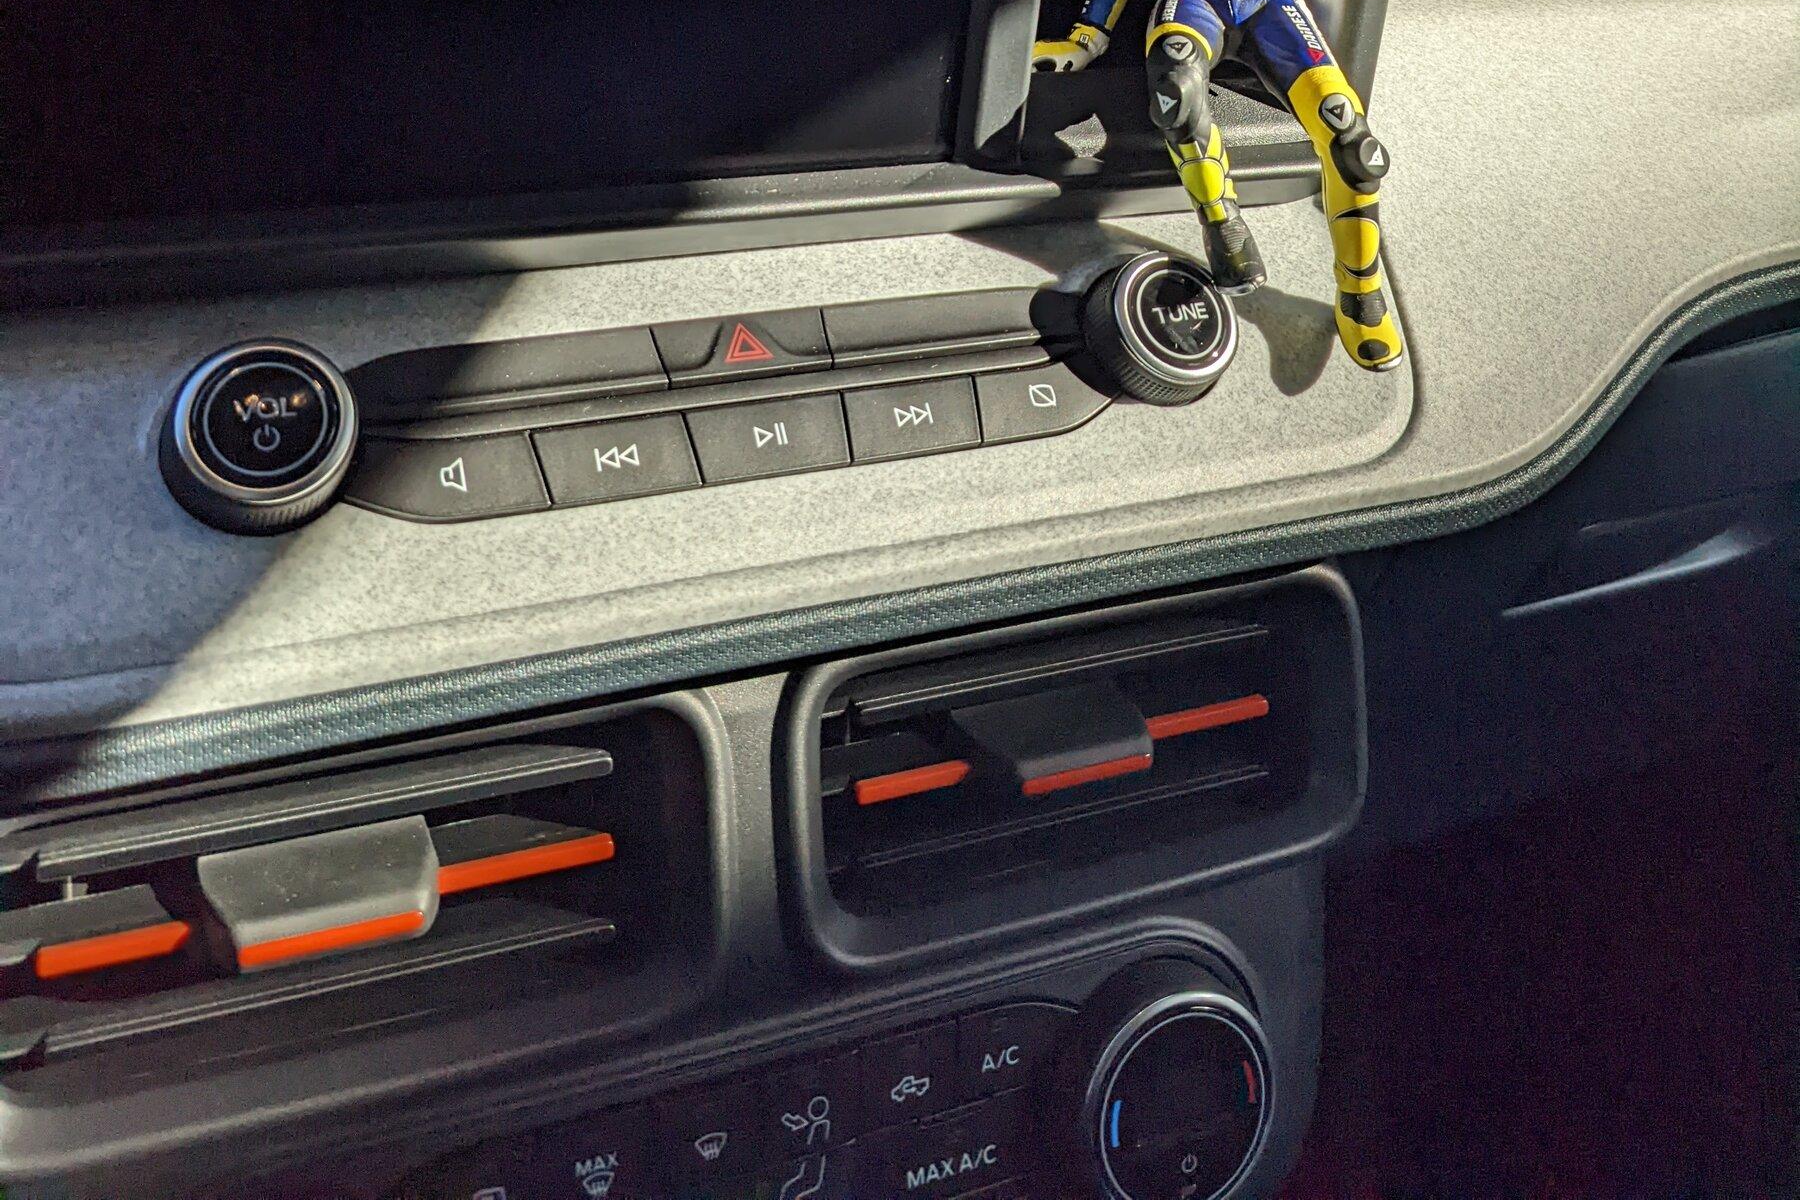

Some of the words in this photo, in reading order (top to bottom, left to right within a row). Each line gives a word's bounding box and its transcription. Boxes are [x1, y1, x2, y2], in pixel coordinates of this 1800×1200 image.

[1151, 301, 1209, 325] TUNE
[233, 396, 298, 422] VOL
[981, 1045, 1020, 1073] A/C
[574, 1151, 620, 1178] MAX
[906, 1158, 955, 1189] MAX
[959, 1144, 998, 1173] A/C
